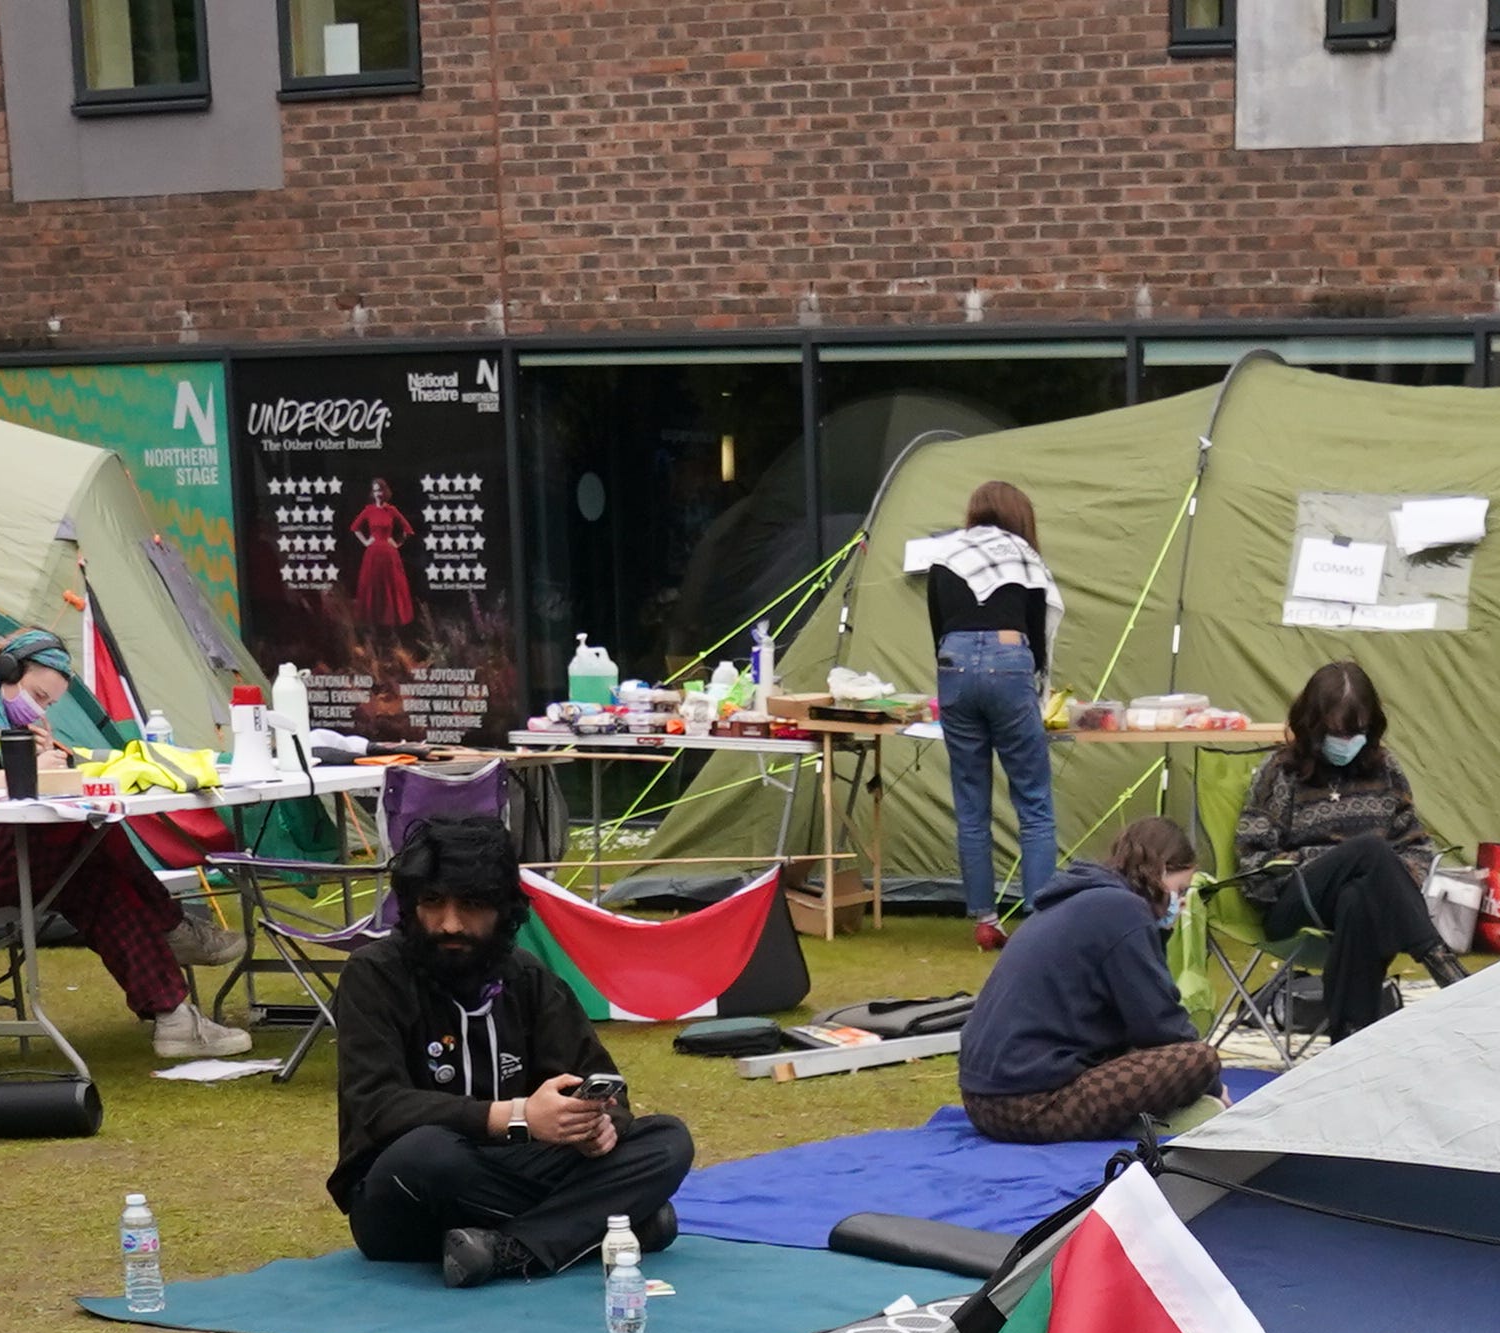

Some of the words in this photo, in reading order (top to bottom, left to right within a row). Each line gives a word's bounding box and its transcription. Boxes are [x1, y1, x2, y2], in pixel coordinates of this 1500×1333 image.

[407, 371, 458, 388] National
[409, 386, 458, 402] Theatre
[262, 440, 281, 452] The
[283, 438, 313, 451] Other
[315, 437, 345, 450] Other
[145, 447, 218, 467] NORTHERN
[176, 466, 219, 486] STAGE
[354, 675, 373, 687] AND
[429, 669, 476, 682] JOYOUSLY
[400, 684, 465, 697] INVIGORATING
[467, 685, 480, 697] AS
[433, 700, 460, 712] WALK
[462, 700, 488, 713] OVER
[409, 715, 428, 728] THE
[430, 715, 482, 728] YORKSHIRE
